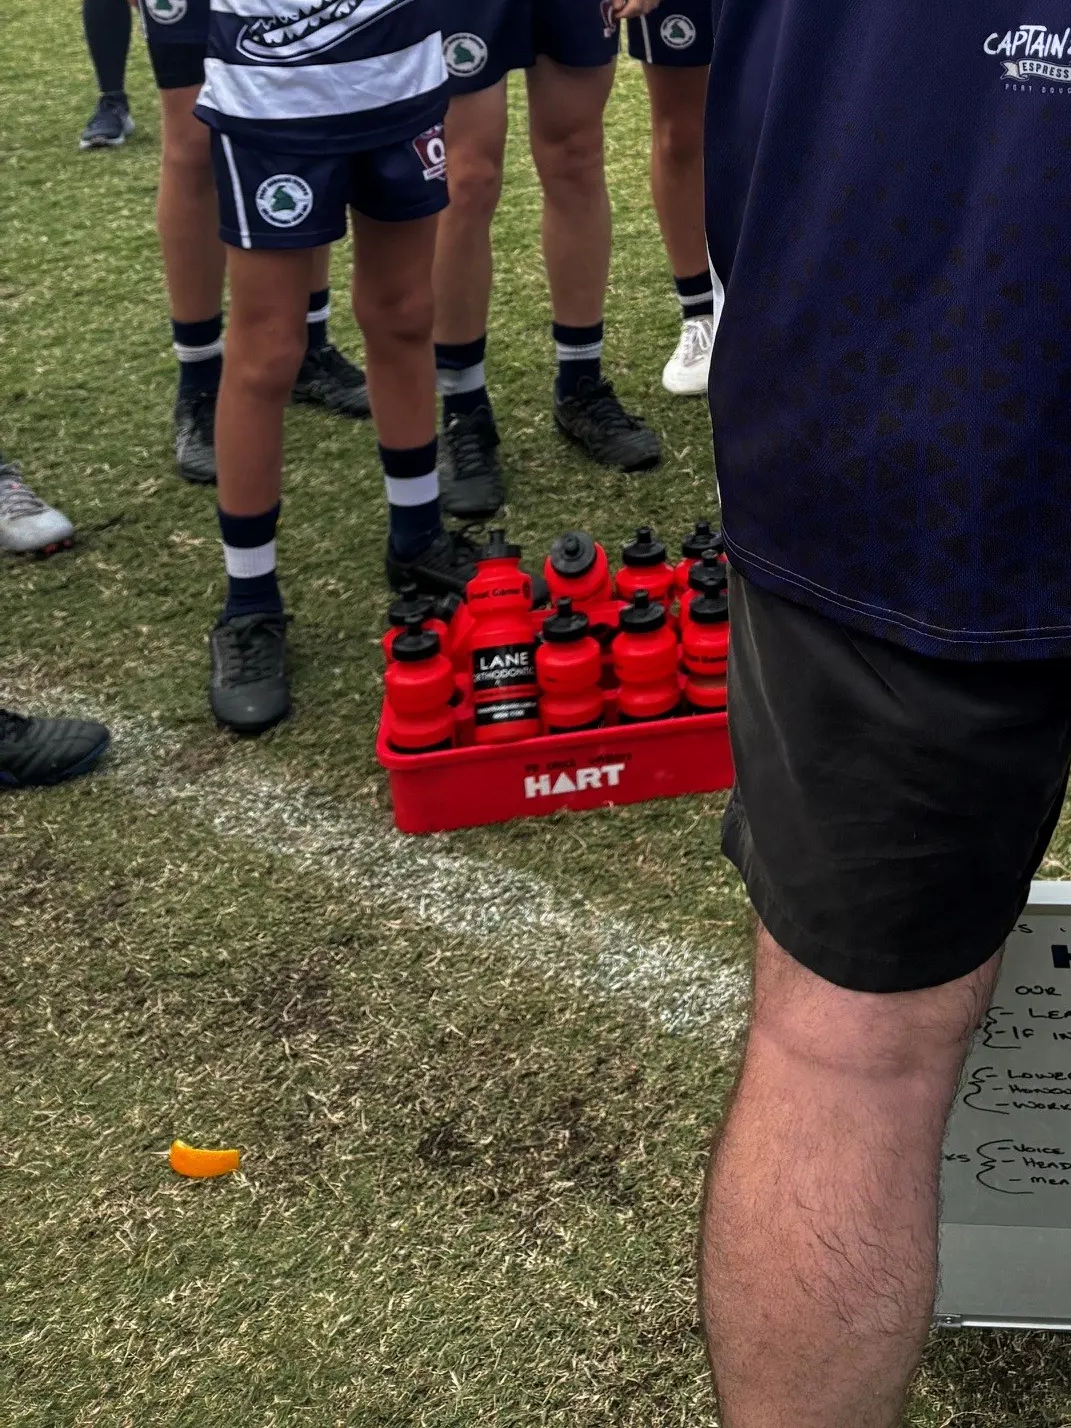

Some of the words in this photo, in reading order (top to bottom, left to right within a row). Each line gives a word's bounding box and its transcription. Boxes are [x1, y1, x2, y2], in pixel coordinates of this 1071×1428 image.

[1005, 83, 1033, 92] PORT
[480, 652, 529, 670] LANE
[524, 763, 625, 799] HART
[1016, 985, 1061, 997] OUR
[1013, 1026, 1034, 1040] IF
[1013, 1144, 1065, 1154] VOICE
